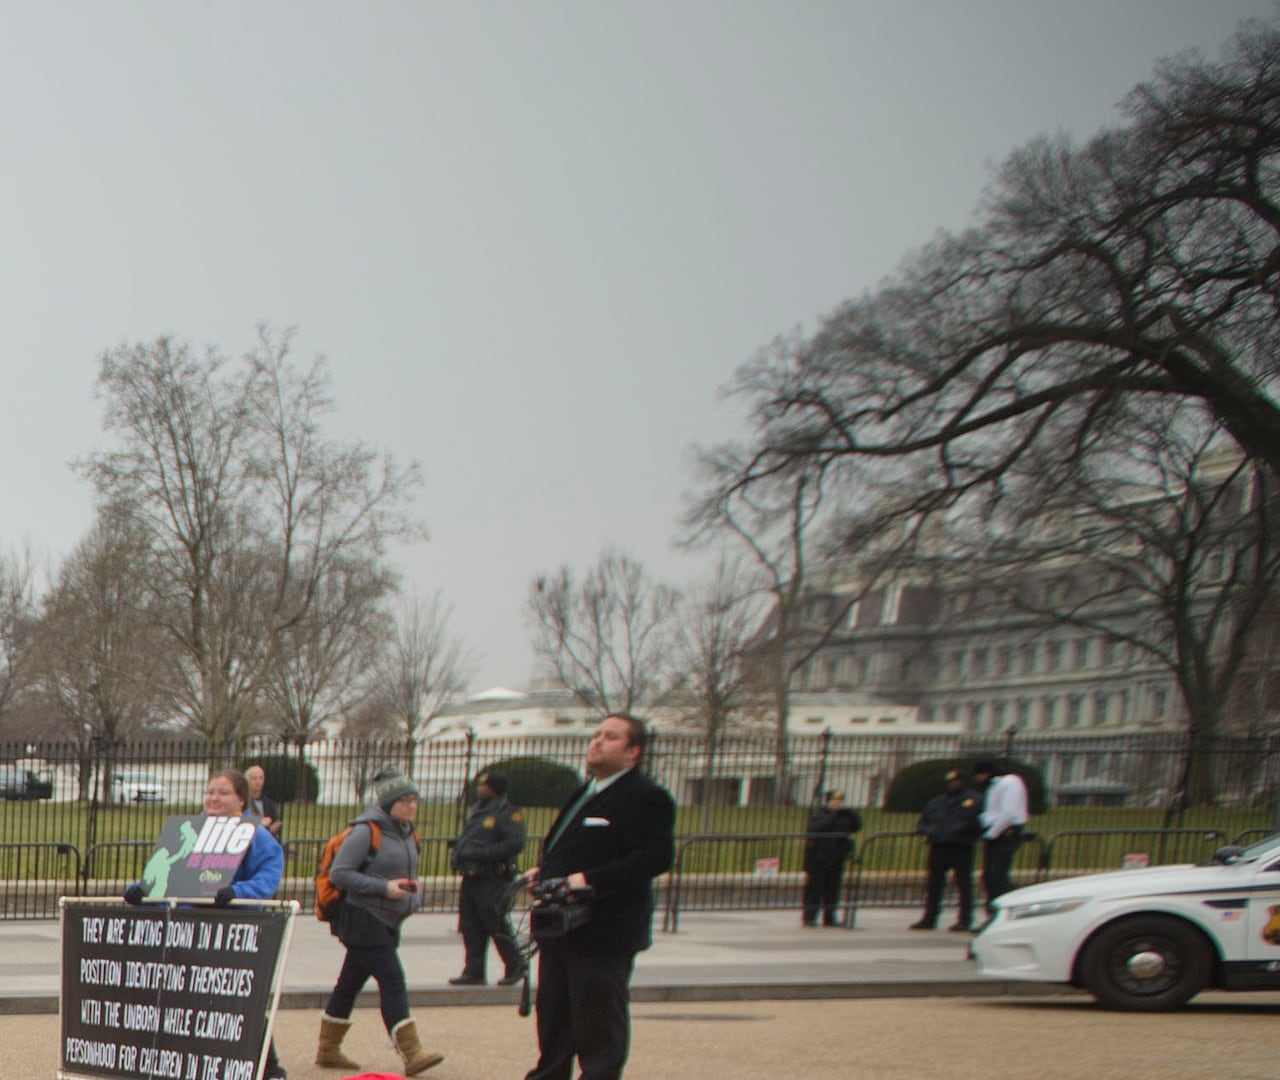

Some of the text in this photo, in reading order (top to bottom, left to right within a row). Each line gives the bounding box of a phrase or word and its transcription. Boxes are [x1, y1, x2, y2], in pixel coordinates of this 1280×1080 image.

[192, 816, 255, 855] life
[82, 918, 259, 953] THEY ARE LAYING DOWN IN A FETAL
[80, 958, 254, 997] POSITION IDENTIFYING THEMSELVES
[81, 999, 244, 1042] WITH THE UNBORN WHILE CLAIMING
[66, 1037, 117, 1069] PERSONHOOD
[119, 1045, 137, 1072] FOR
[140, 1047, 183, 1080] CHILDREN
